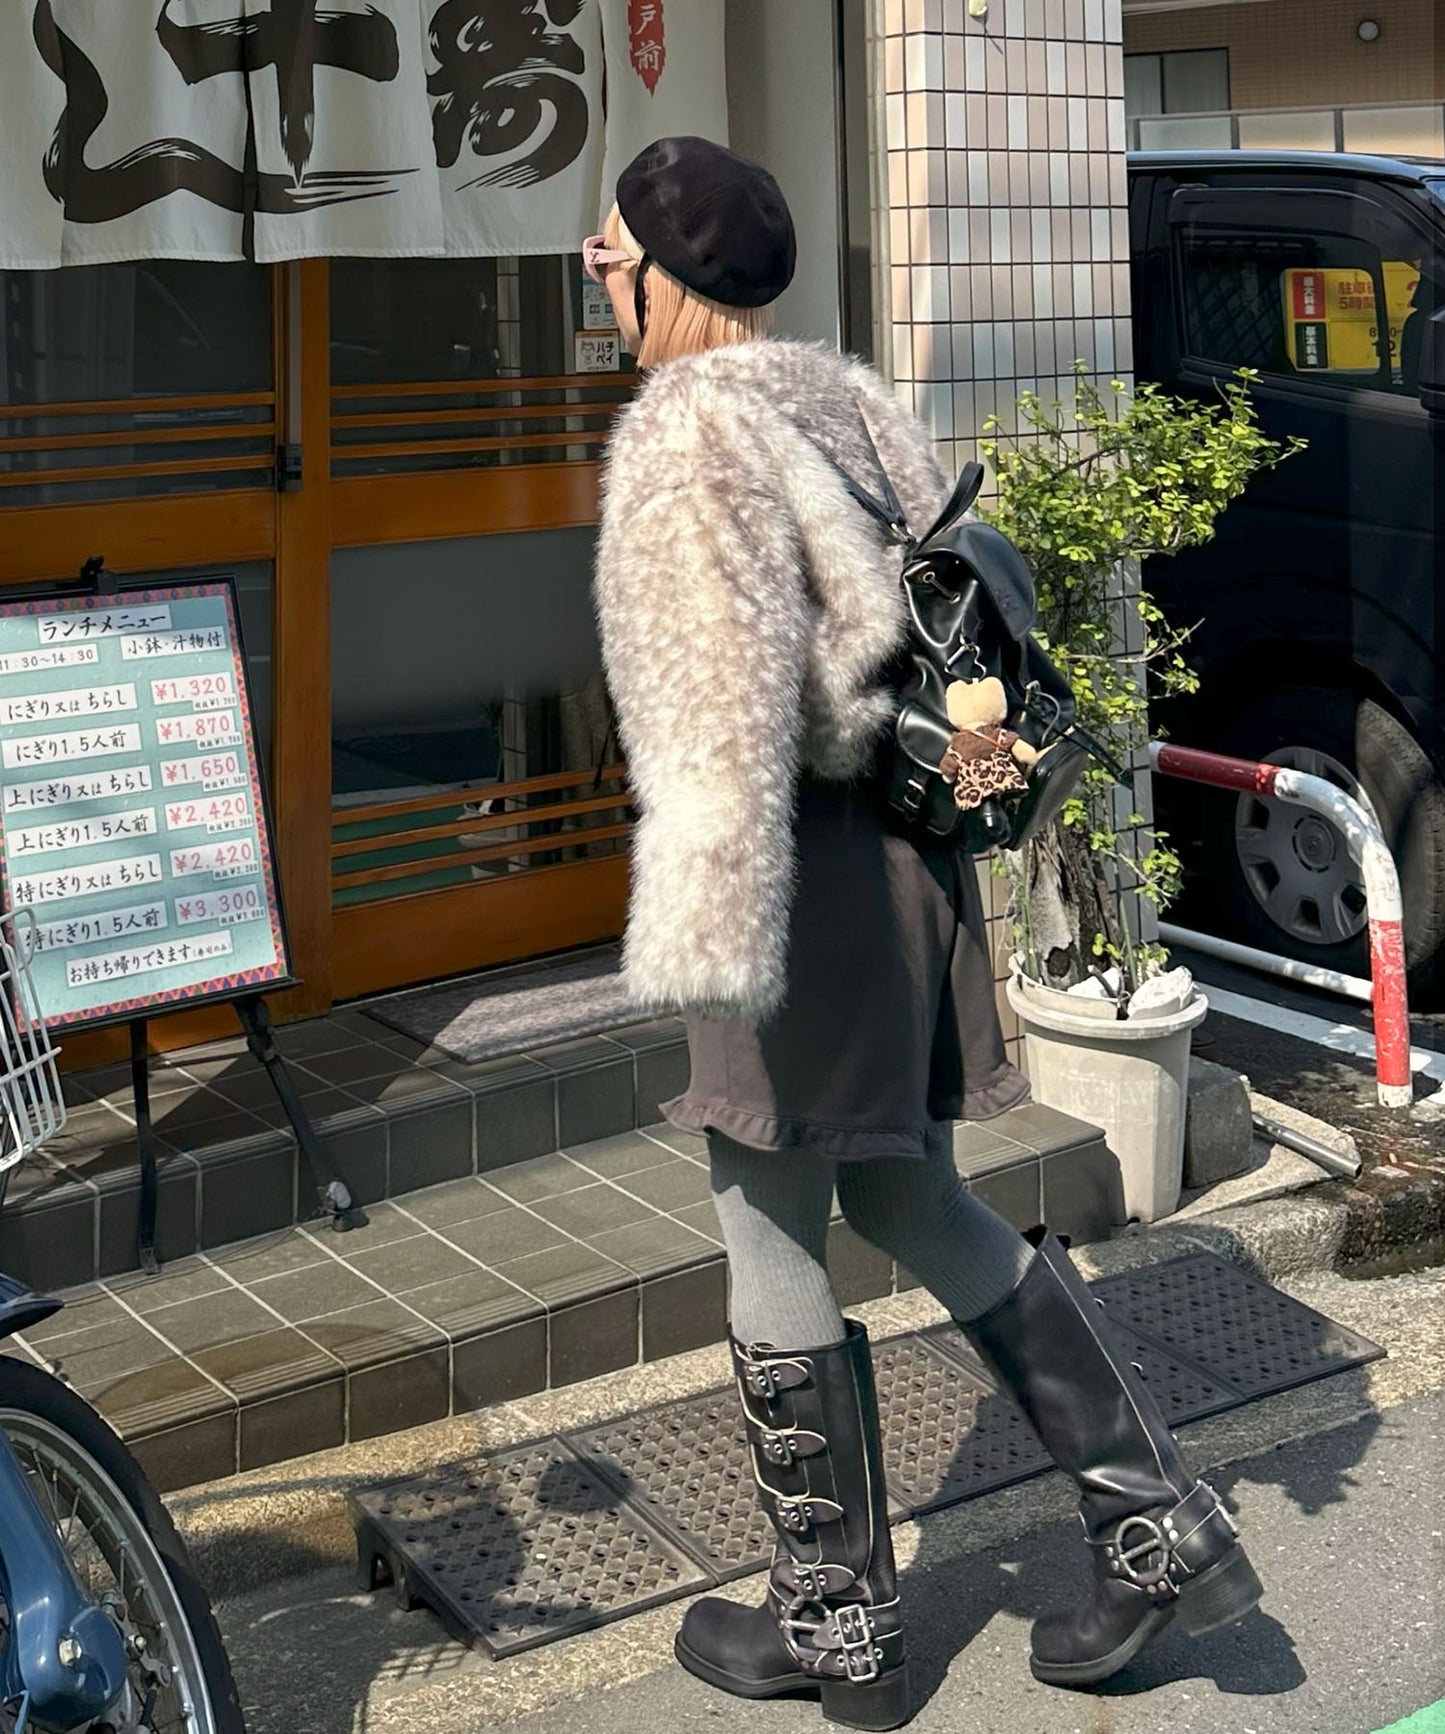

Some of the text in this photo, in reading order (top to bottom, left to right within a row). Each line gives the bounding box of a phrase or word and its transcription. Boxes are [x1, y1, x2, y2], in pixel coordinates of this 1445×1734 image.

[43, 615, 166, 640] ランチメニュー
